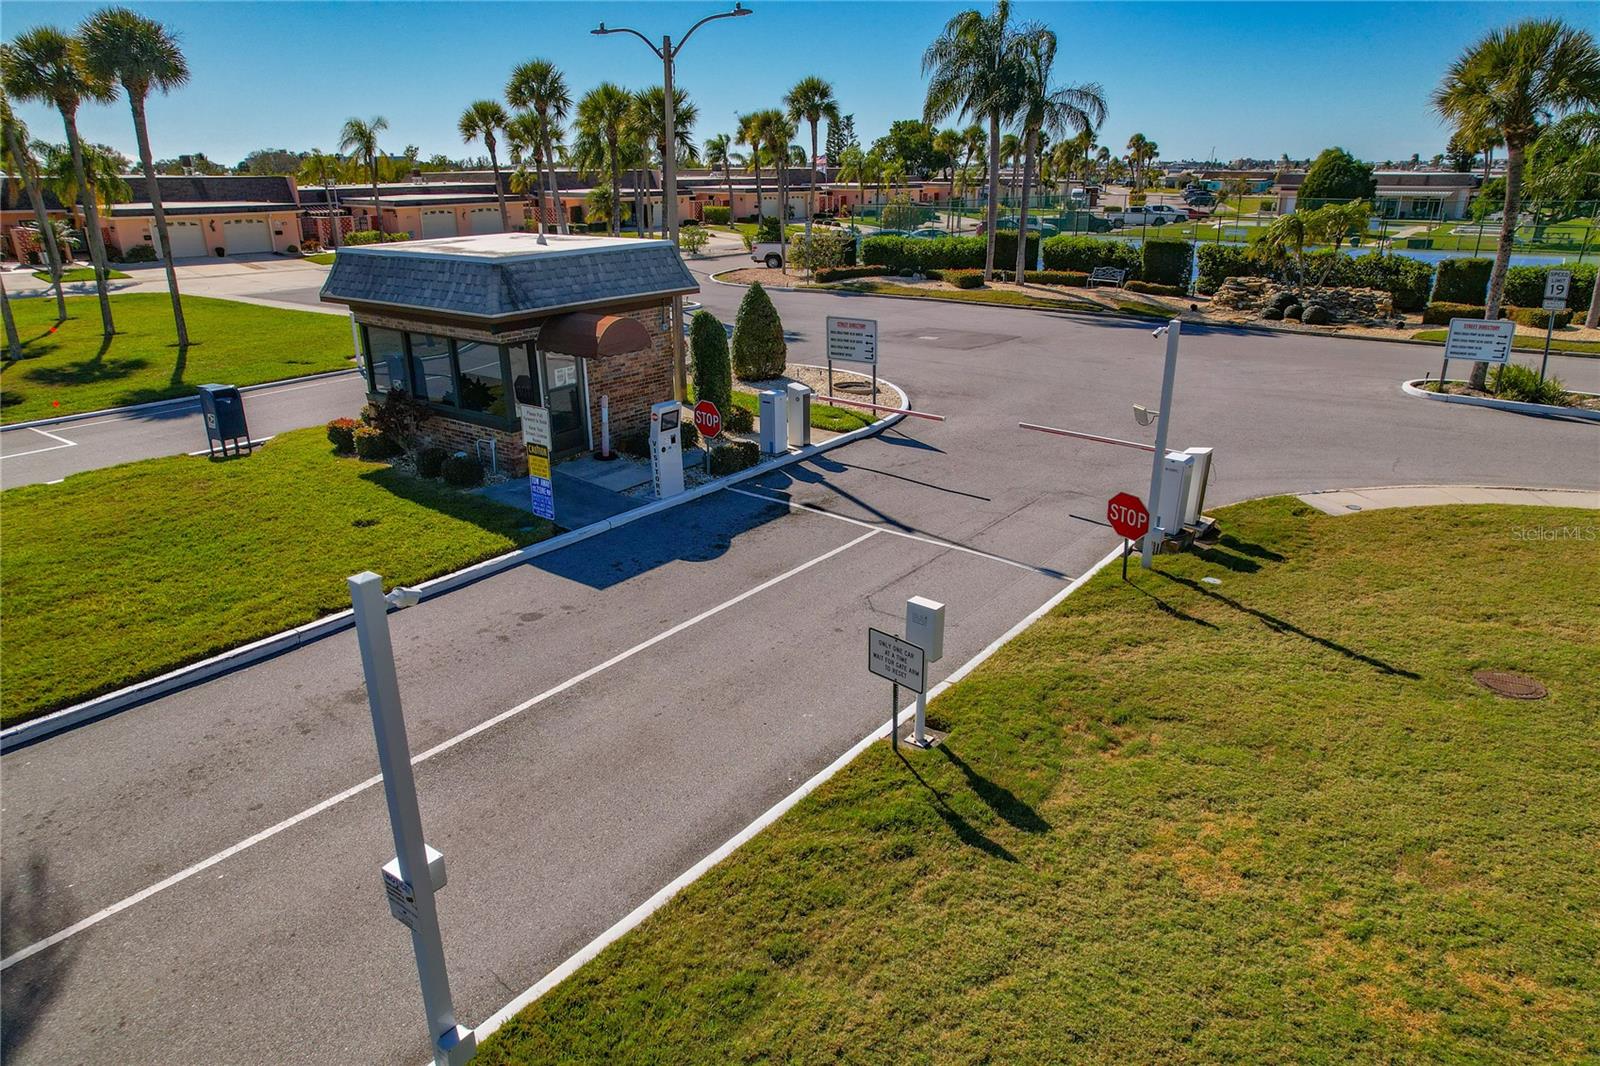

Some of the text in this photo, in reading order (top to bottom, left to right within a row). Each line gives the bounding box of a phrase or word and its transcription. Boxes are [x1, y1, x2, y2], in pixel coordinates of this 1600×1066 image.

[1550, 284, 1565, 295] 19
[695, 410, 720, 428] STOP
[652, 440, 661, 496] VISITORS
[1110, 503, 1147, 529] STOP
[878, 639, 892, 649] ONLY
[892, 645, 903, 655] ONE
[873, 652, 884, 661] WAIT
[884, 656, 895, 666] FOR
[895, 661, 908, 672] GATE
[896, 654, 908, 664] TIME
[884, 663, 907, 679] TO RESET
